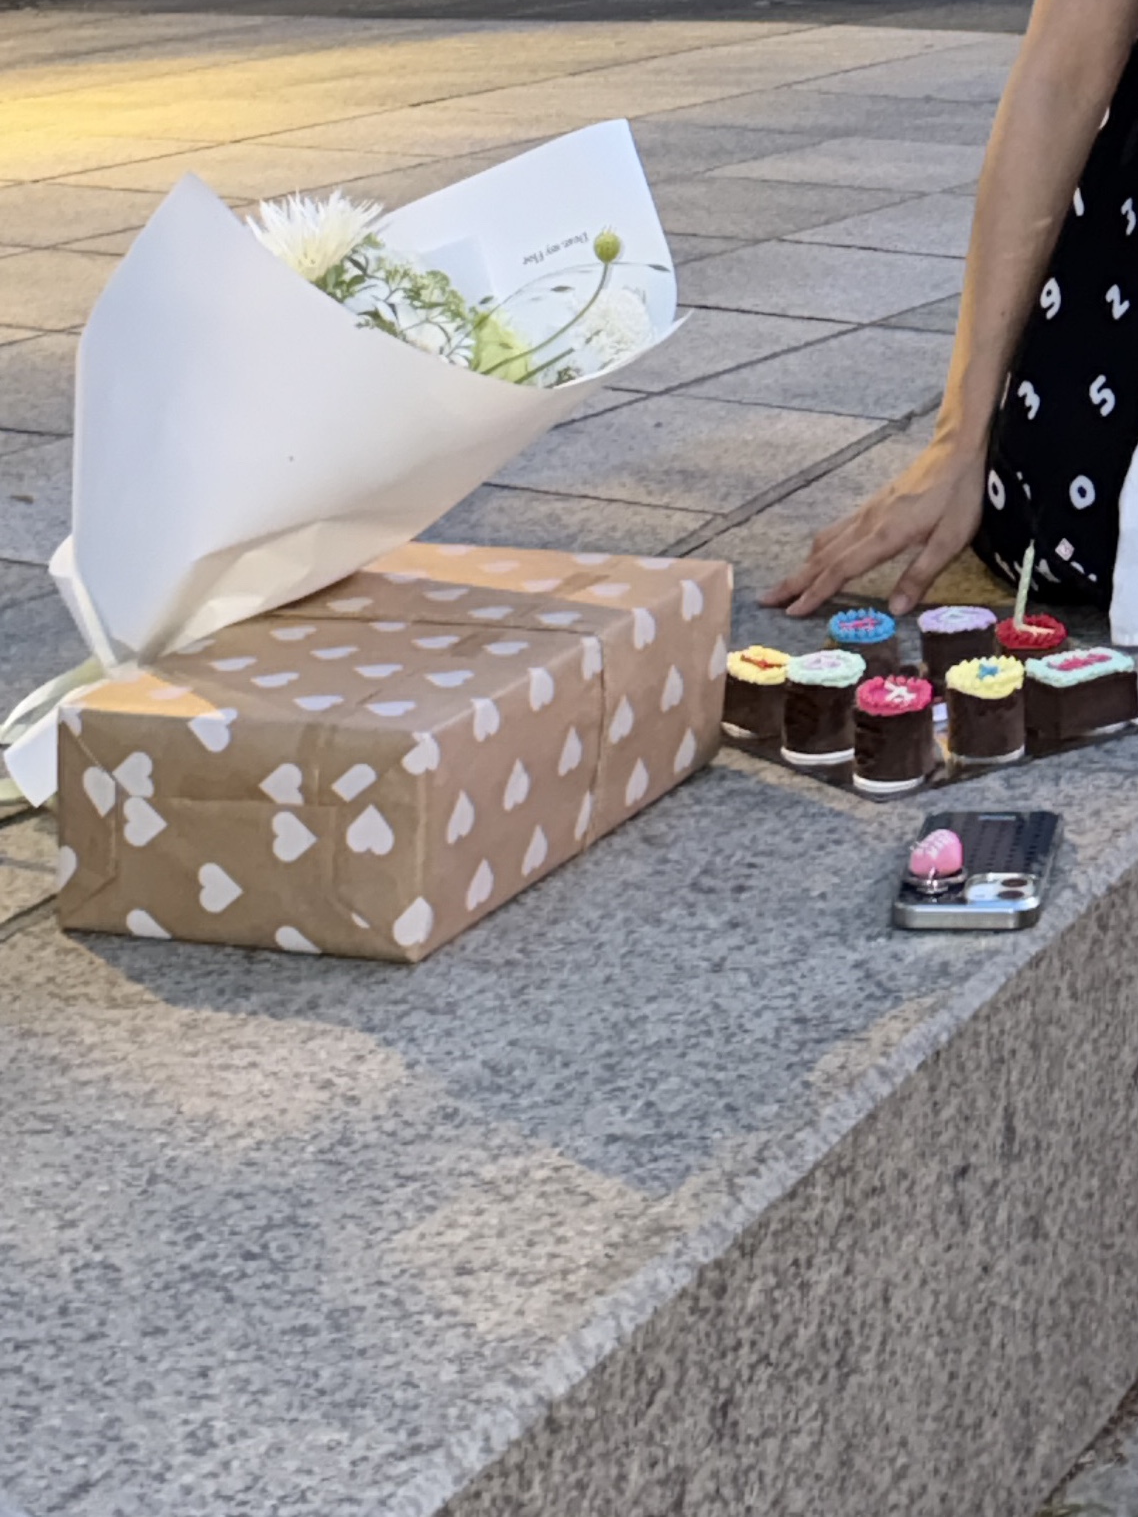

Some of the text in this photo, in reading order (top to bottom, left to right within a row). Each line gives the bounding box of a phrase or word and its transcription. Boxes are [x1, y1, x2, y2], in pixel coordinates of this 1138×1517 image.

[1040, 277, 1062, 320] 9
[1105, 284, 1130, 320] 2
[1017, 380, 1041, 420] 3
[1088, 374, 1116, 417] 5
[987, 469, 1006, 510] 0
[1069, 475, 1096, 510] 0
